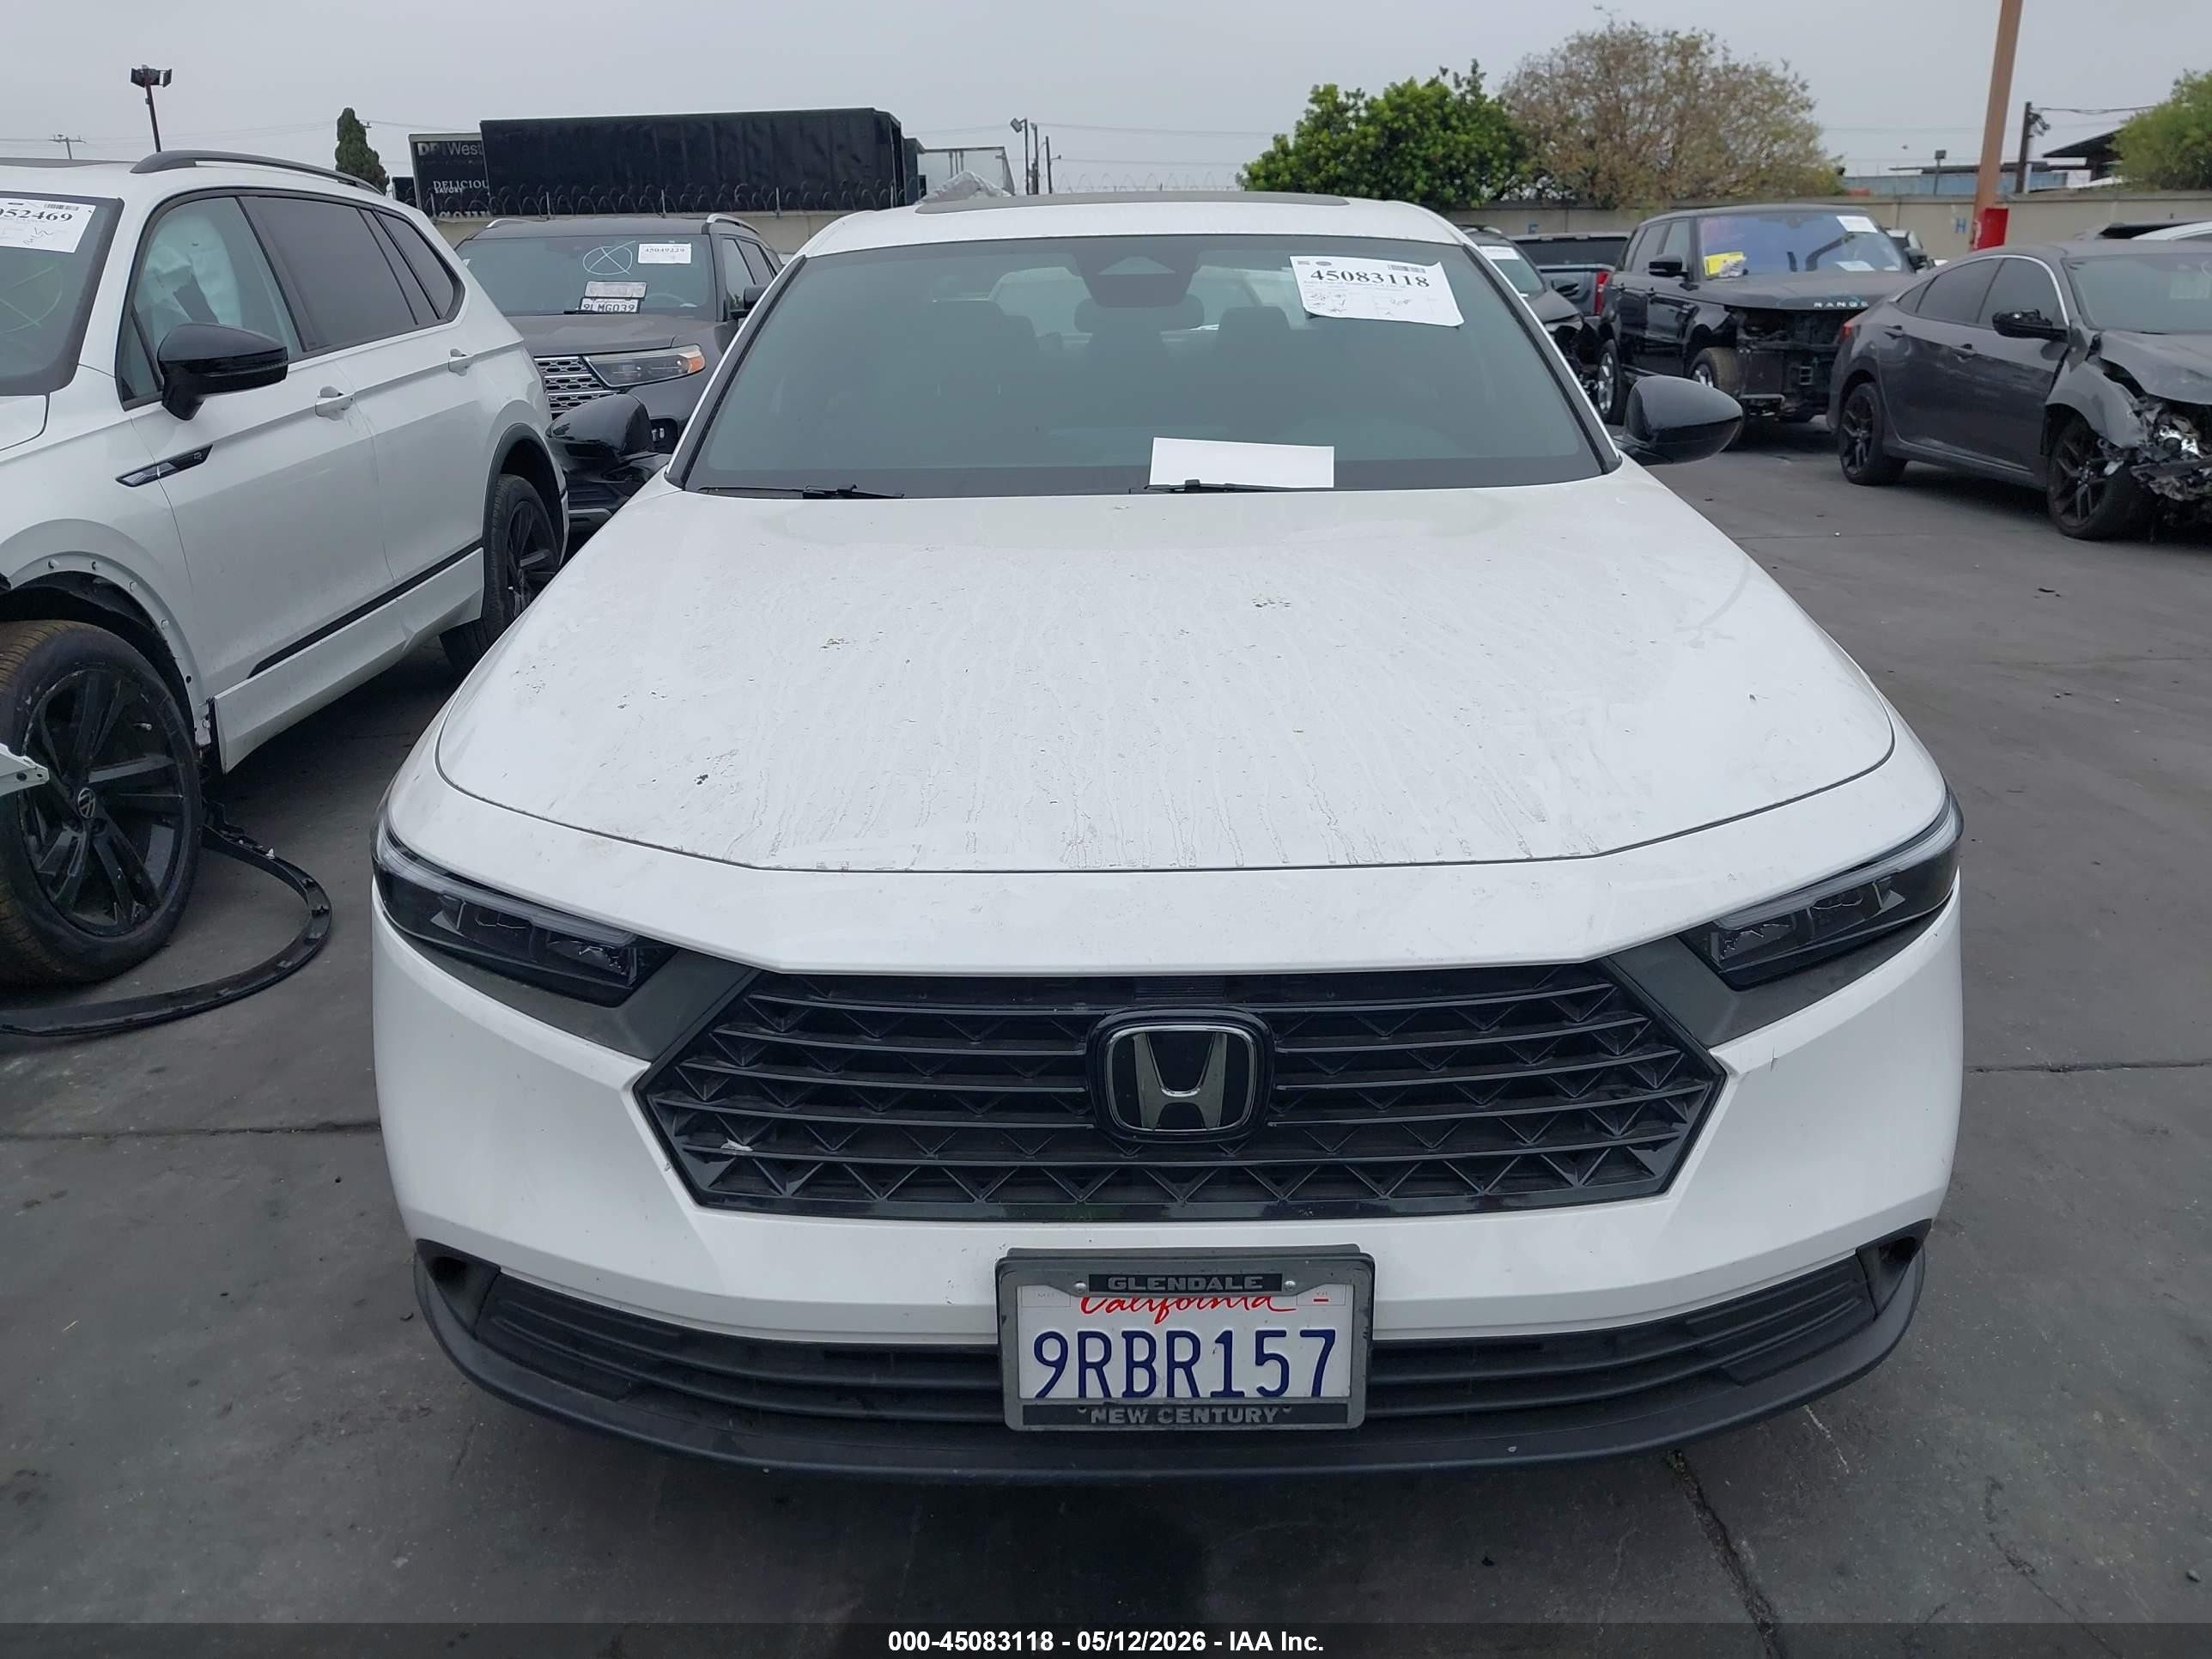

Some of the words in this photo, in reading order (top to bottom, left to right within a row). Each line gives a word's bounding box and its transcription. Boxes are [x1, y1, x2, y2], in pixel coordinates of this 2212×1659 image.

[1310, 269, 1430, 288] 45083118
[1108, 1276, 1263, 1291] GLENDALE
[1033, 1329, 1336, 1398] 9RBR157
[1091, 1407, 1149, 1424] NEW
[1158, 1407, 1279, 1425] CENTURY
